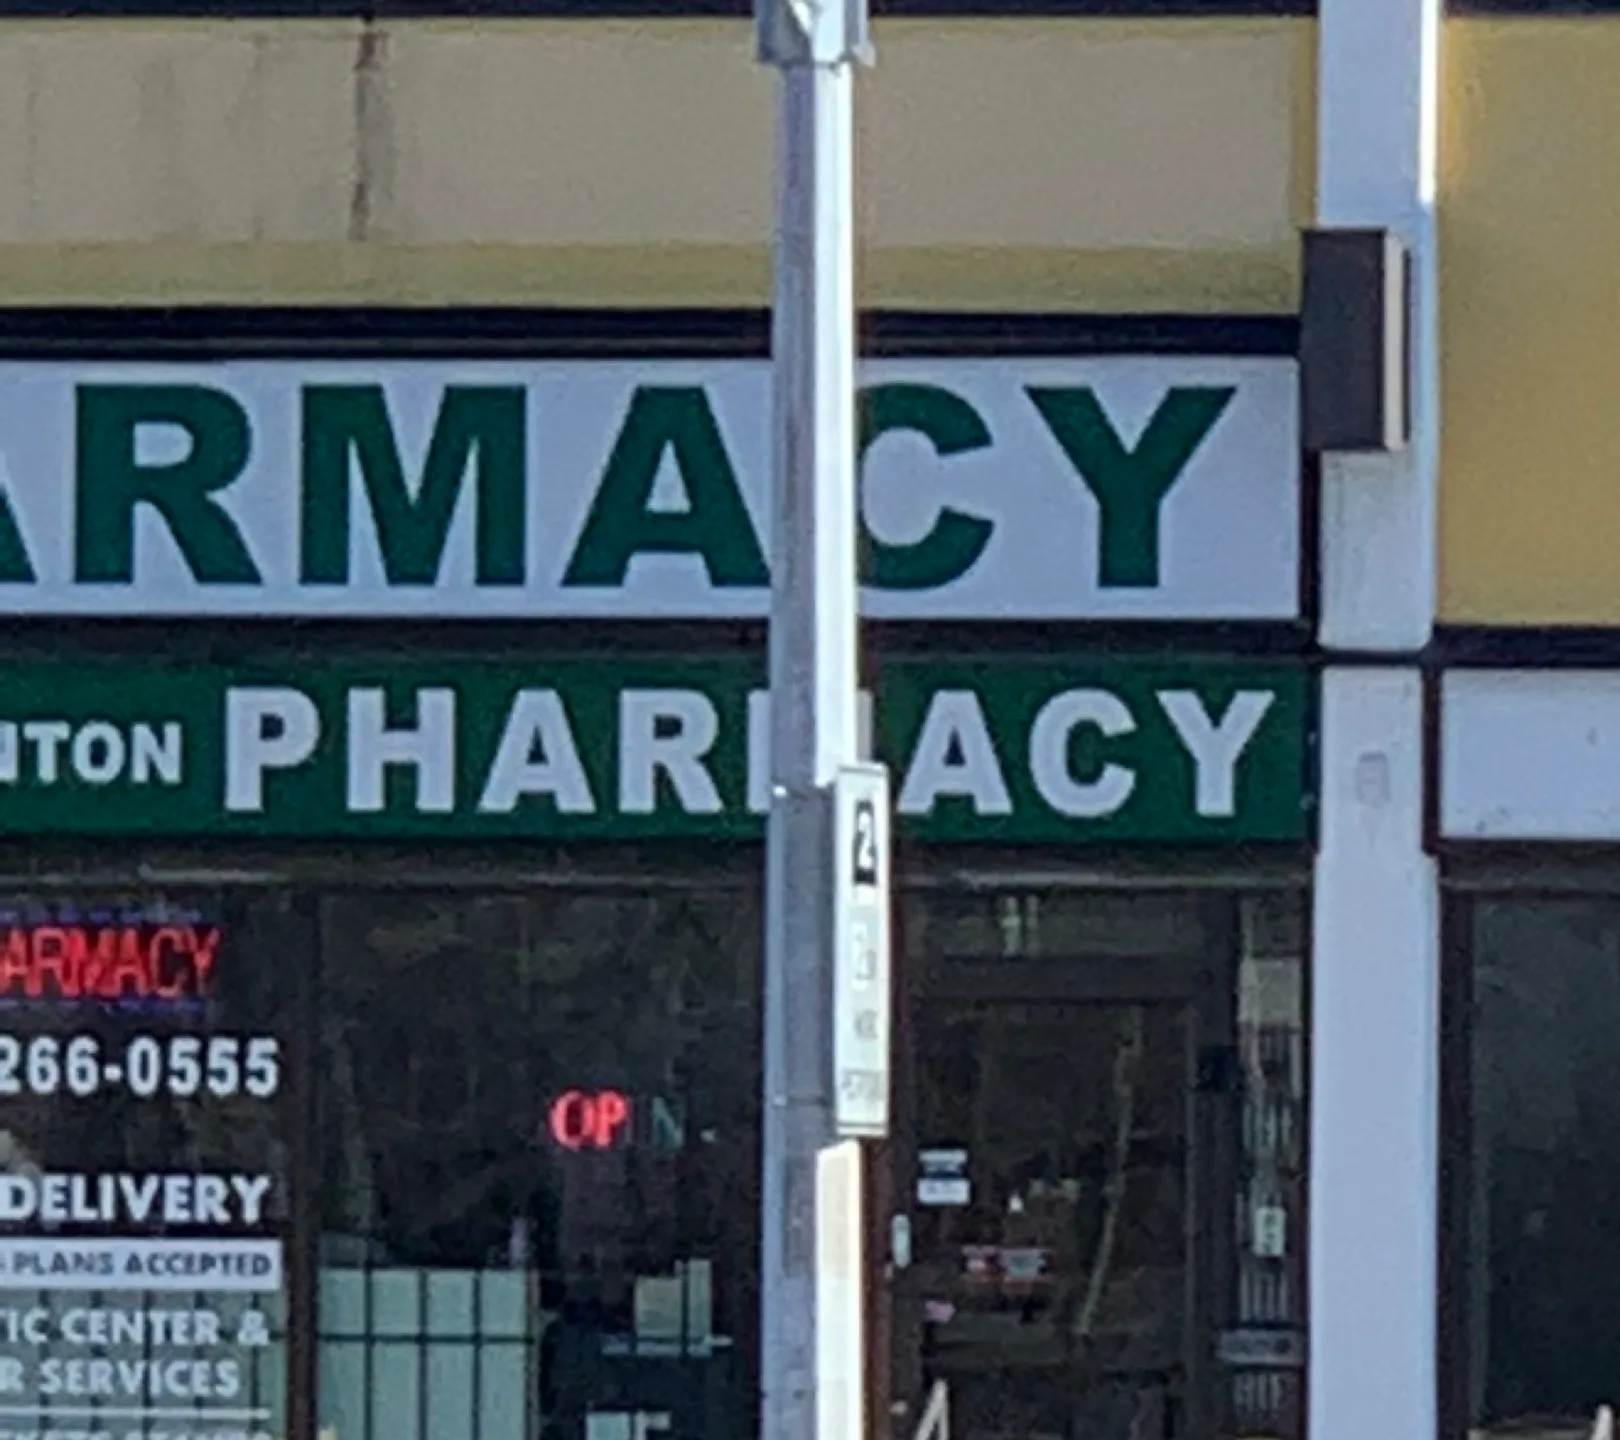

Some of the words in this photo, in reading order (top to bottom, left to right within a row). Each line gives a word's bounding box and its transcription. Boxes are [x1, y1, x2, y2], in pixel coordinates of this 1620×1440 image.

[0, 381, 1238, 590] RMACY
[0, 1034, 280, 1097] 266-0555
[0, 1173, 270, 1224] DELIVERY
[12, 1251, 115, 1276] PLANS
[123, 1252, 273, 1277] ACCEPTED
[0, 1307, 49, 1345] IC
[60, 1308, 221, 1346] CENTER
[237, 1309, 270, 1347] &
[39, 1357, 241, 1398] SERVICES
